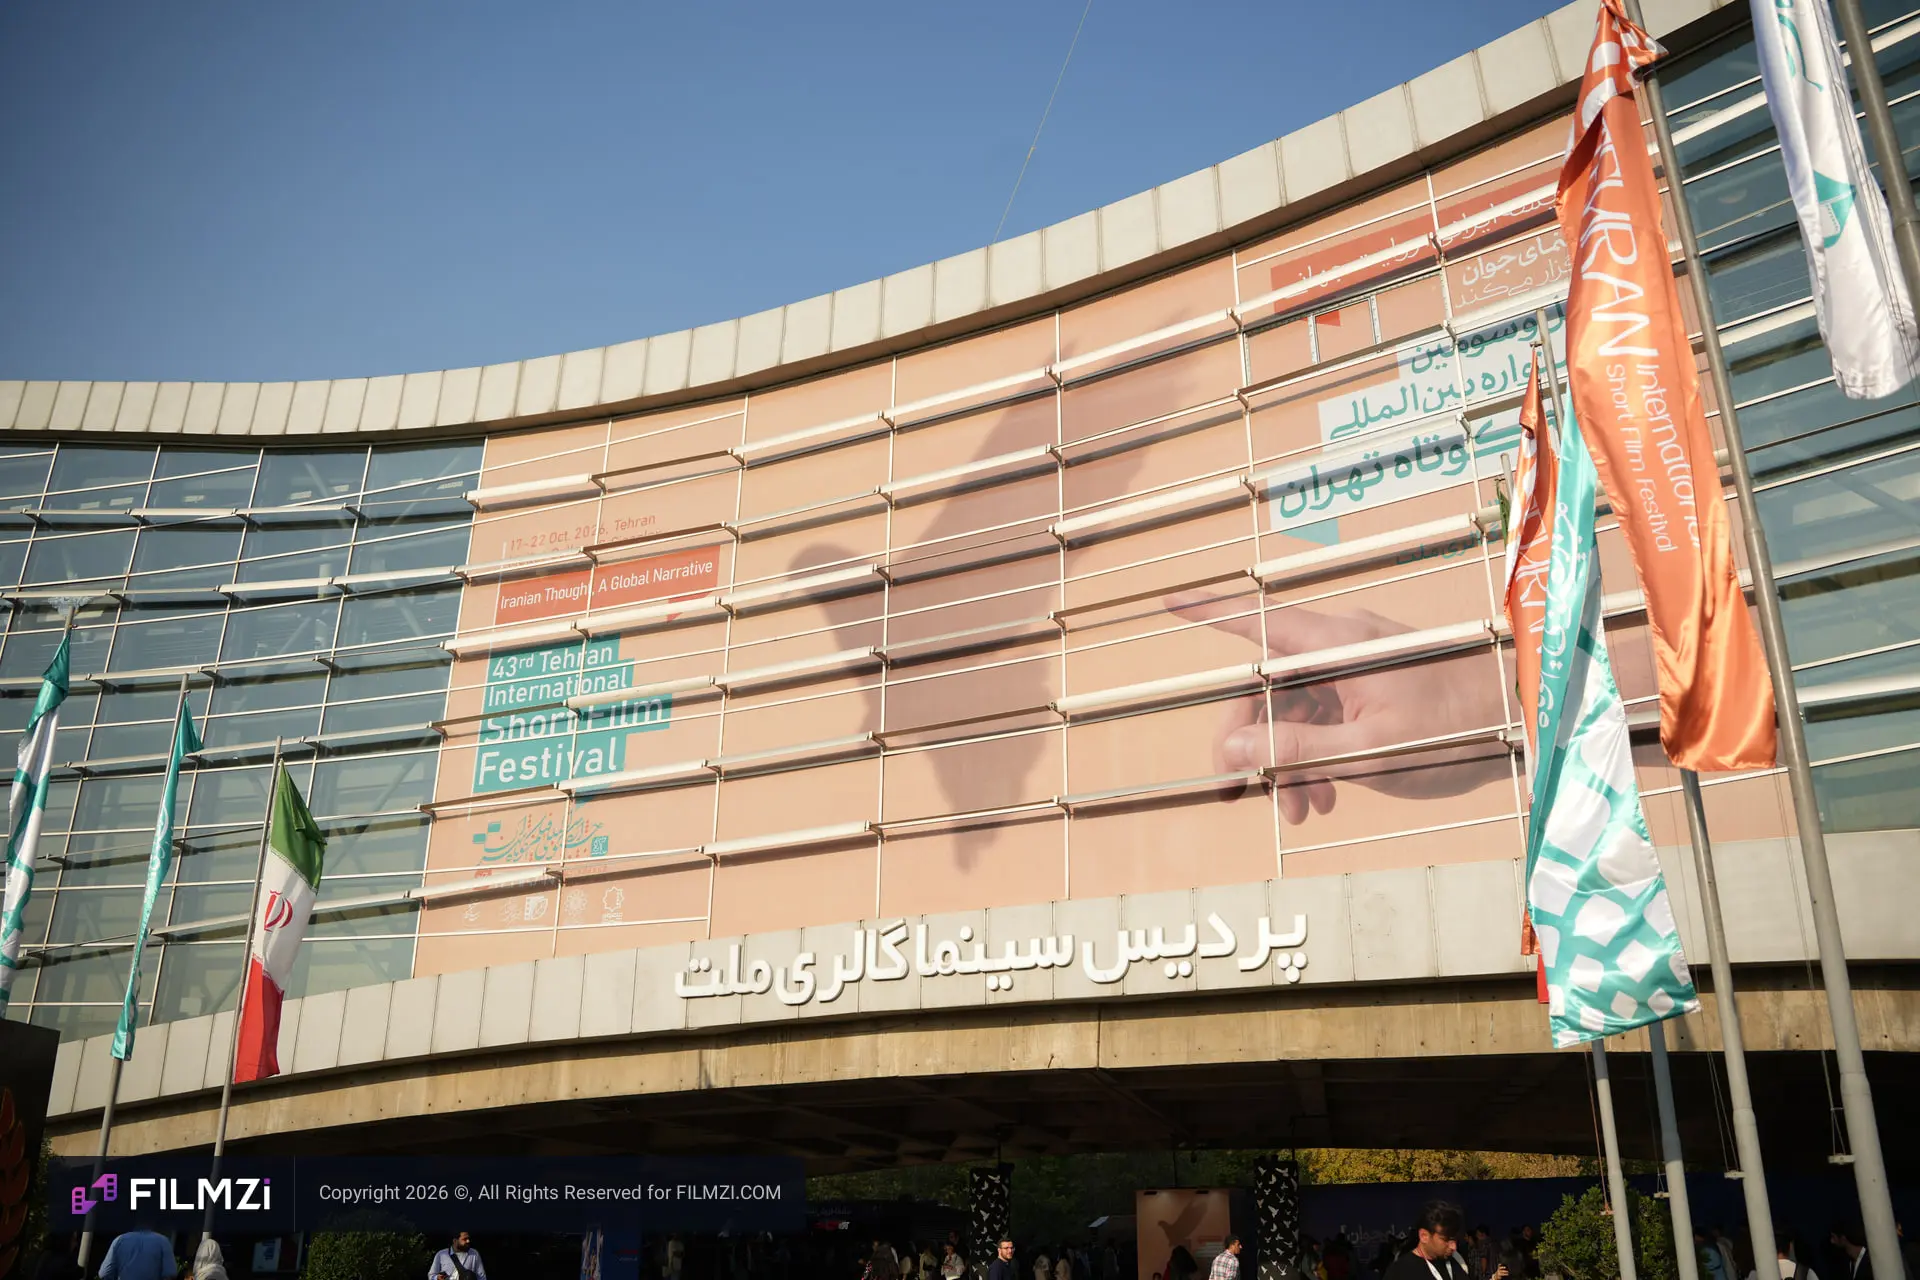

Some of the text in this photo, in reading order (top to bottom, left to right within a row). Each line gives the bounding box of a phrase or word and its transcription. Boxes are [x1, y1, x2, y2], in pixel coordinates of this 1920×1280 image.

[1462, 231, 1568, 287] نمای جوان
[1606, 363, 1680, 554] Short Film Festival
[1279, 450, 1385, 519] تهران
[614, 514, 656, 532] Tehran
[500, 559, 714, 610] Iranian Though, A Global Narrative
[488, 666, 627, 707] International
[492, 645, 613, 679] 43rd Tehran
[484, 706, 578, 744] Short
[478, 736, 617, 786] Festival
[674, 911, 1308, 1006] پردیس سینما گالری ملت
